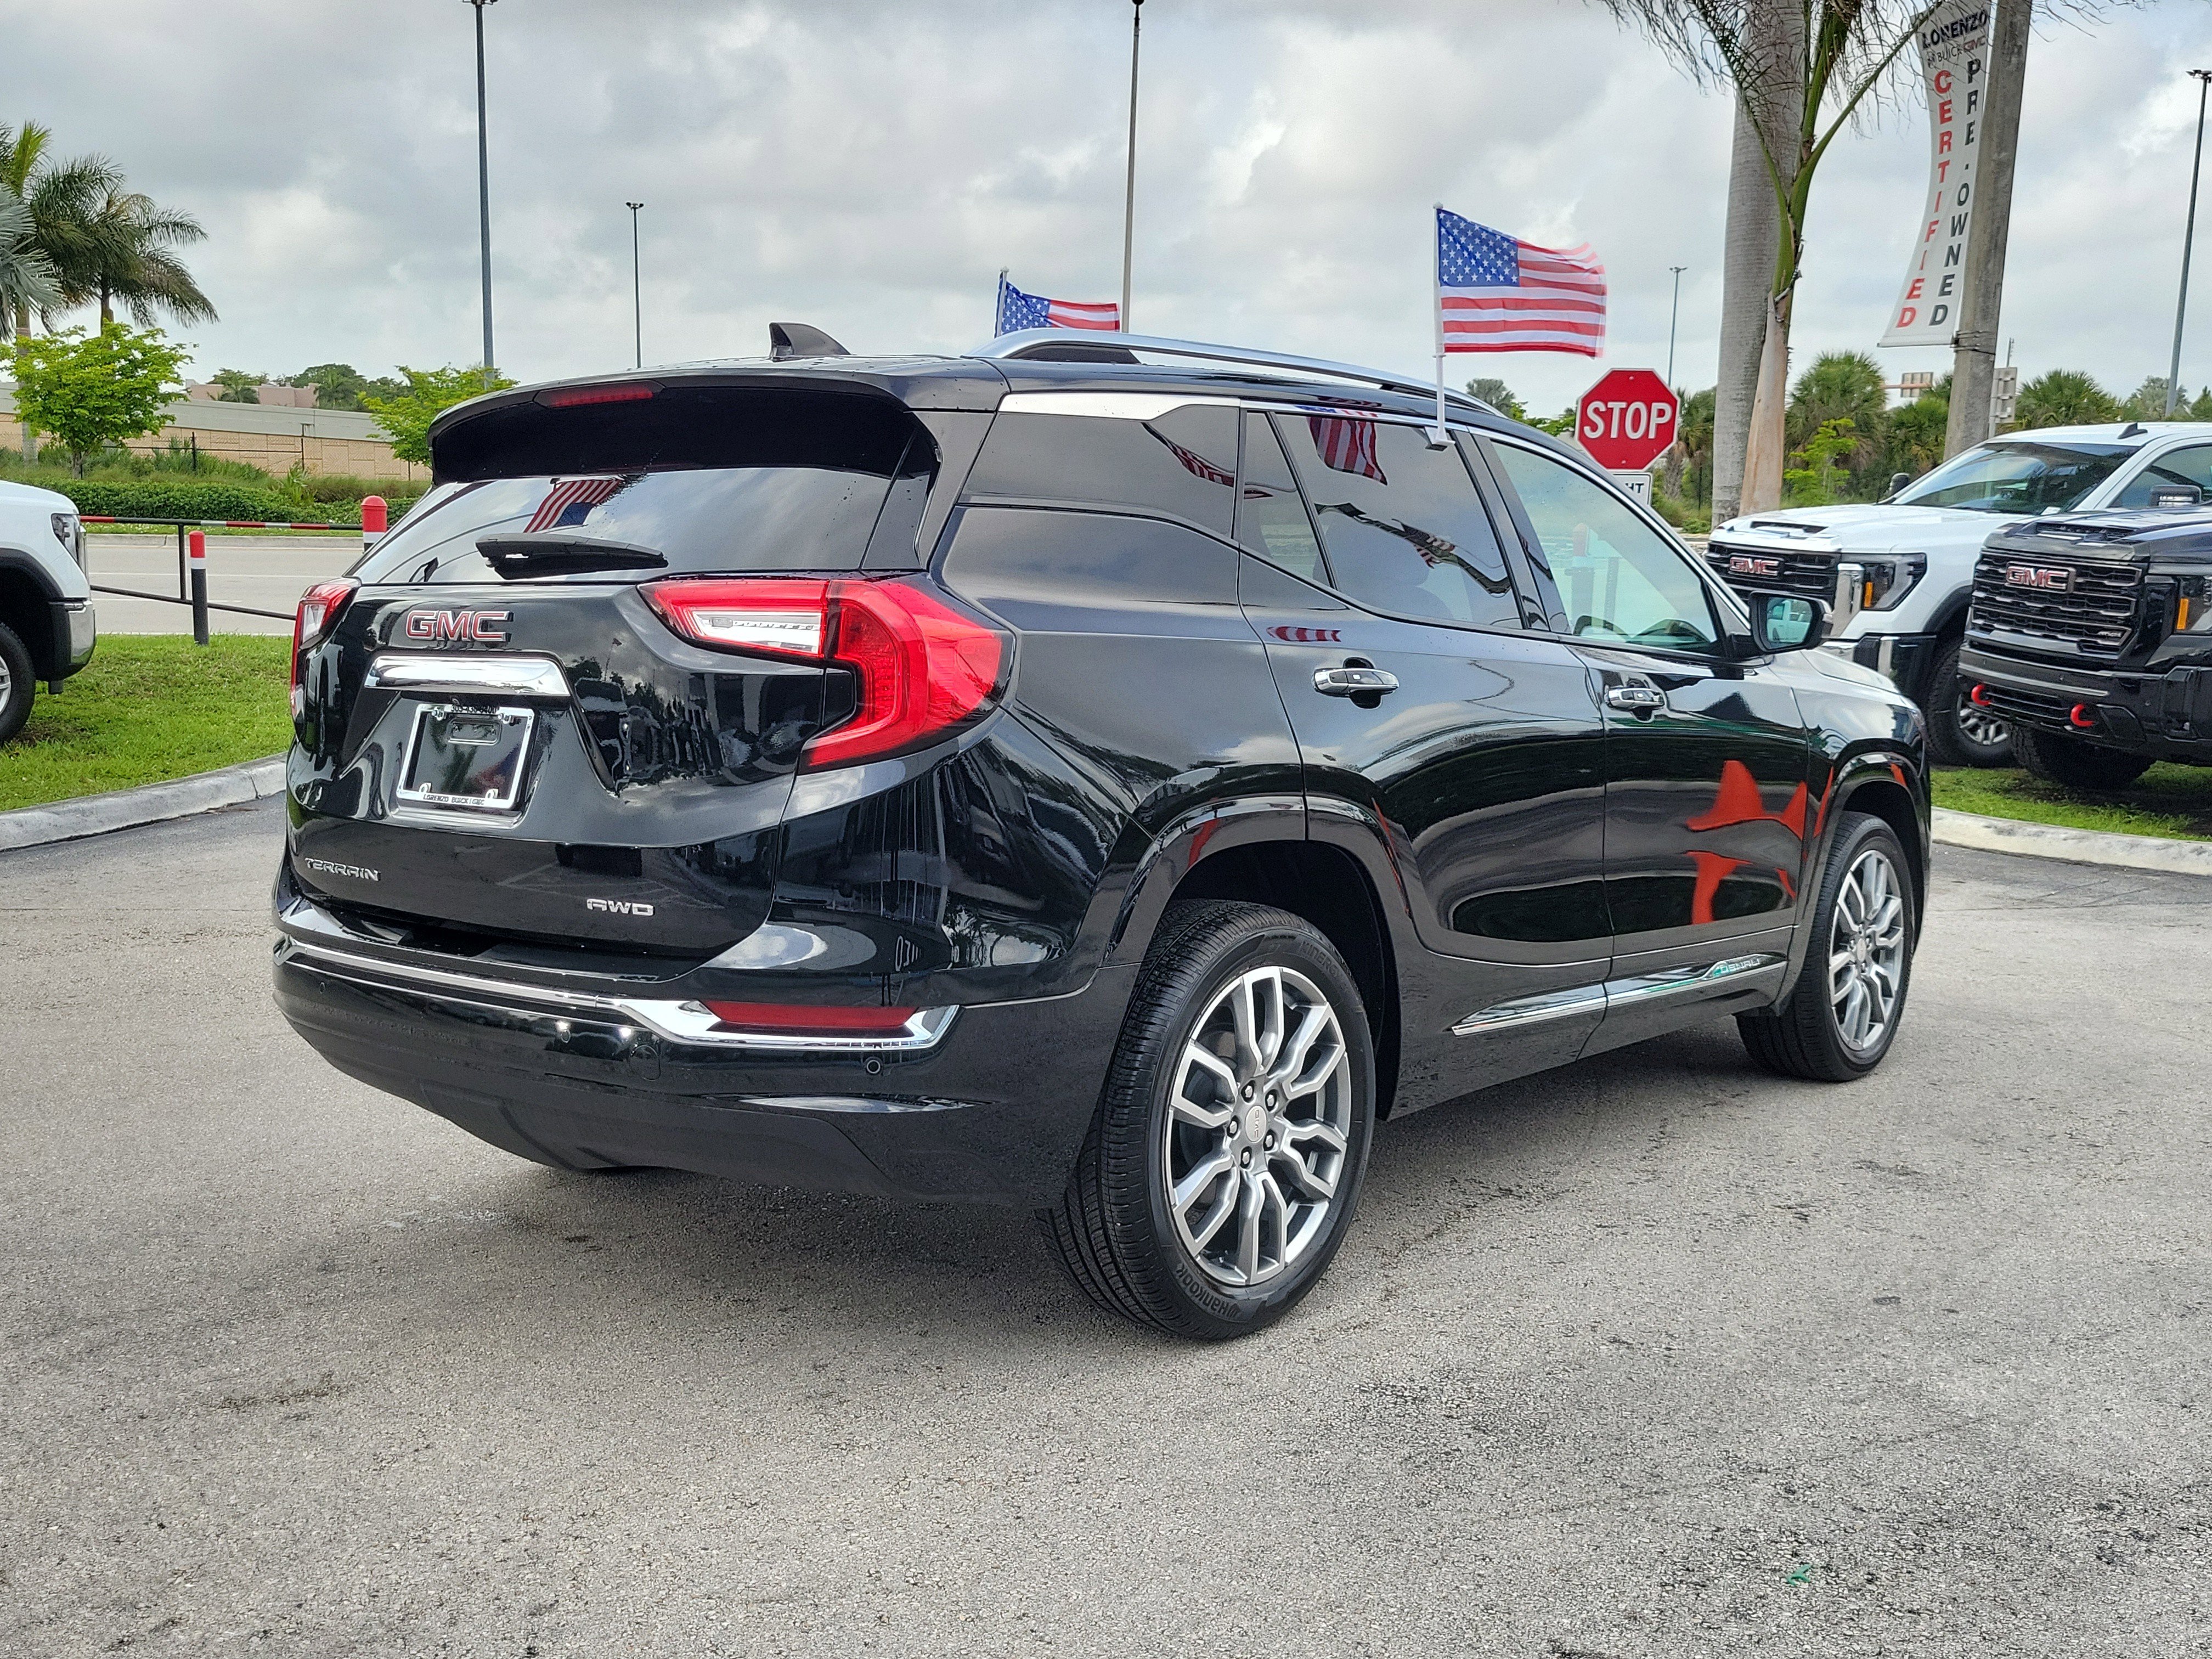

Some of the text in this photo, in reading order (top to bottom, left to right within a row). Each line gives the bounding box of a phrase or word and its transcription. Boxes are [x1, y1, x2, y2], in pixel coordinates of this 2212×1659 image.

[1922, 9, 1987, 49] LORENZO
[1937, 43, 1962, 62] BUICK
[1895, 69, 1953, 328] CERTIFIED
[1583, 401, 1672, 439] STOP
[1729, 556, 1780, 576] GMC
[2006, 566, 2069, 590] GMC
[405, 610, 514, 642] GMC
[423, 794, 449, 802] LORENZO
[304, 857, 381, 882] TERRAIN
[586, 898, 655, 916] AWD
[1721, 958, 1760, 973] DENALI
